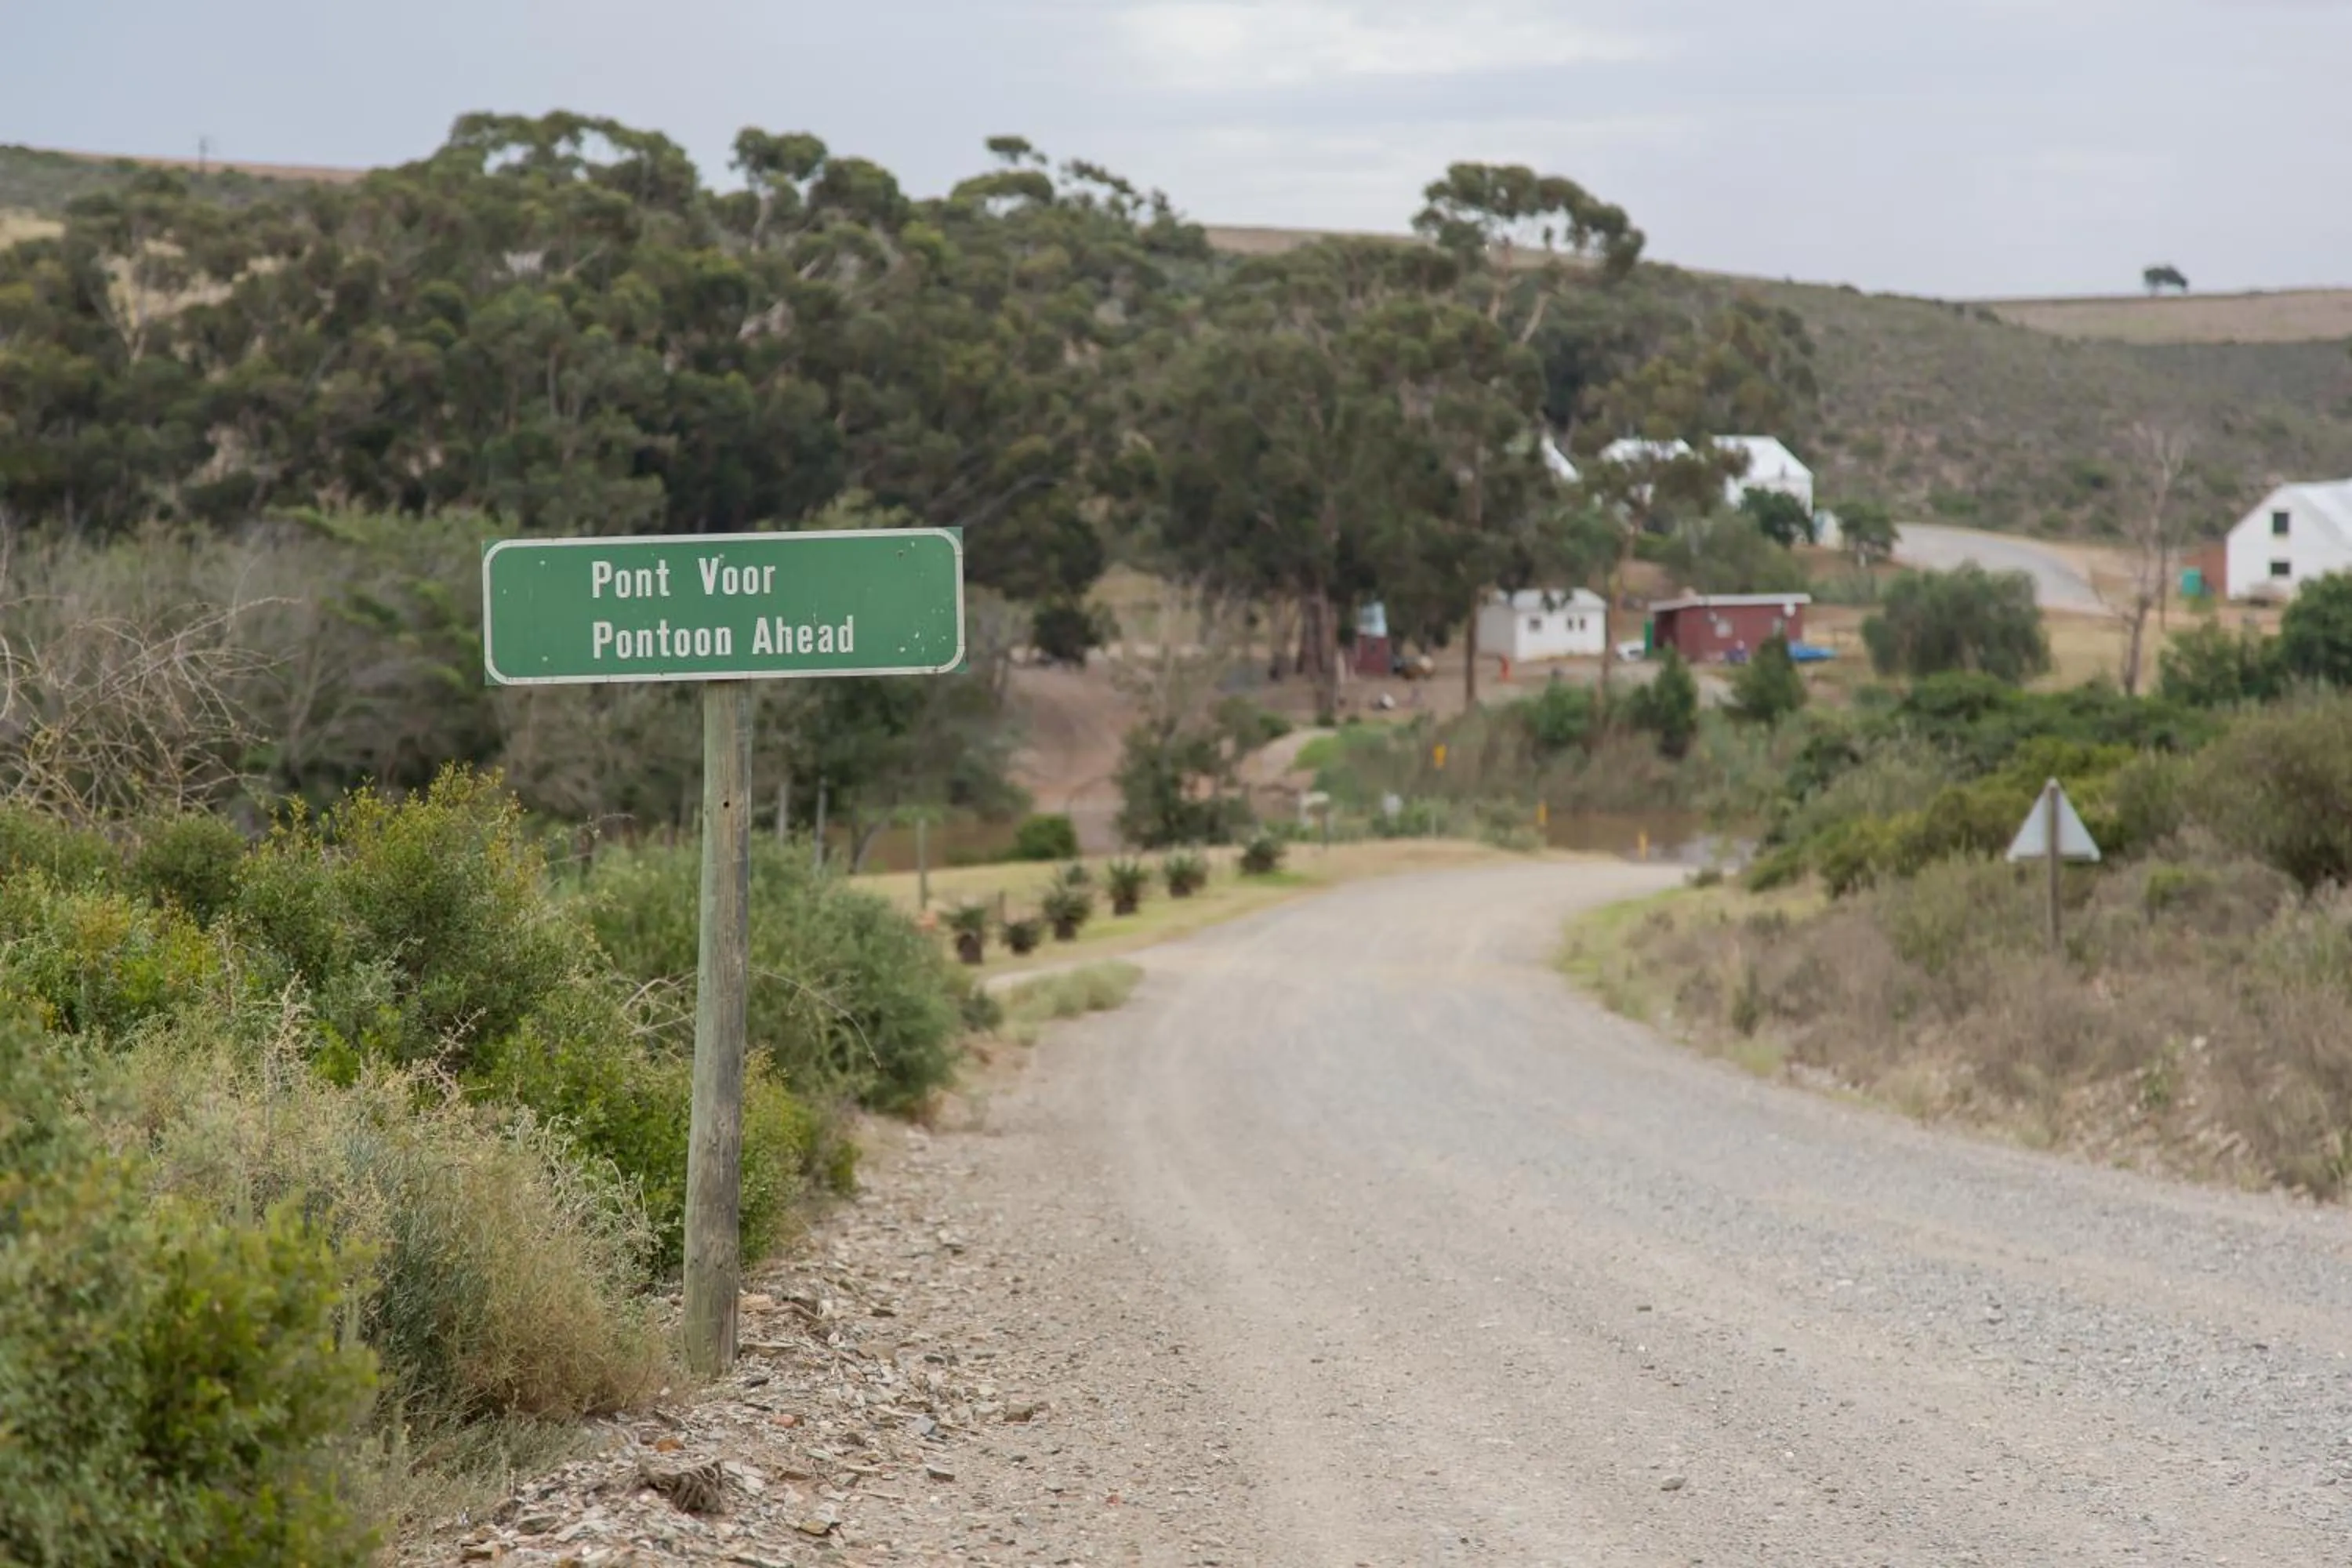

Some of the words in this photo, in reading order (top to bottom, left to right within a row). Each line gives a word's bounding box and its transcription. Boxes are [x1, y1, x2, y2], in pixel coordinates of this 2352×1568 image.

[591, 559, 670, 598] Pont
[698, 557, 775, 595] Voor
[592, 619, 732, 659] Pontoon
[752, 615, 855, 655] Ahead
